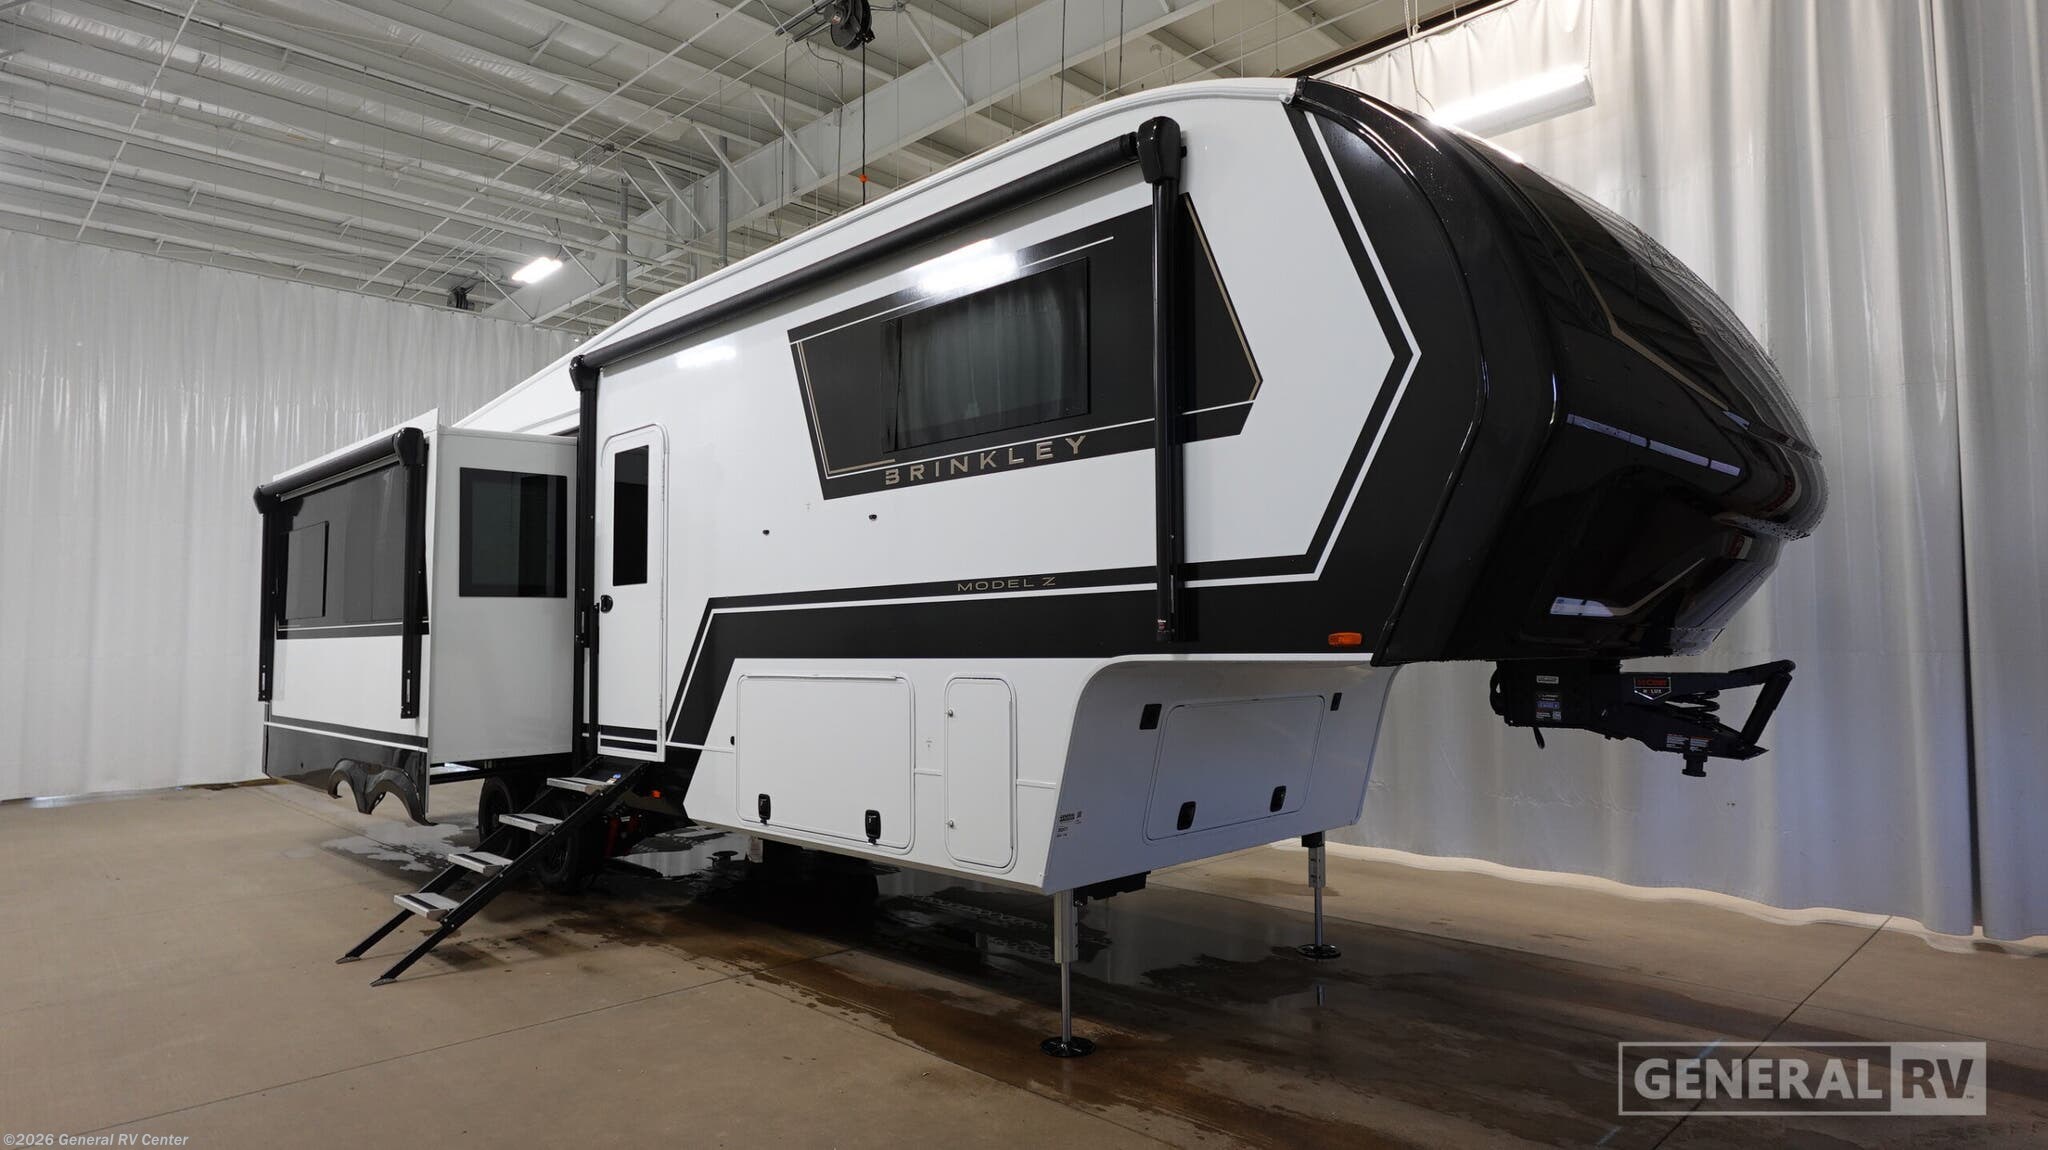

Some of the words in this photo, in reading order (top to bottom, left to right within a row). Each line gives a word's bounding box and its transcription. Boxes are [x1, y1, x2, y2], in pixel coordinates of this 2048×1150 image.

[885, 435, 1087, 485] BRINKLEY
[957, 579, 1034, 592] MODEL
[1042, 576, 1056, 586] Z
